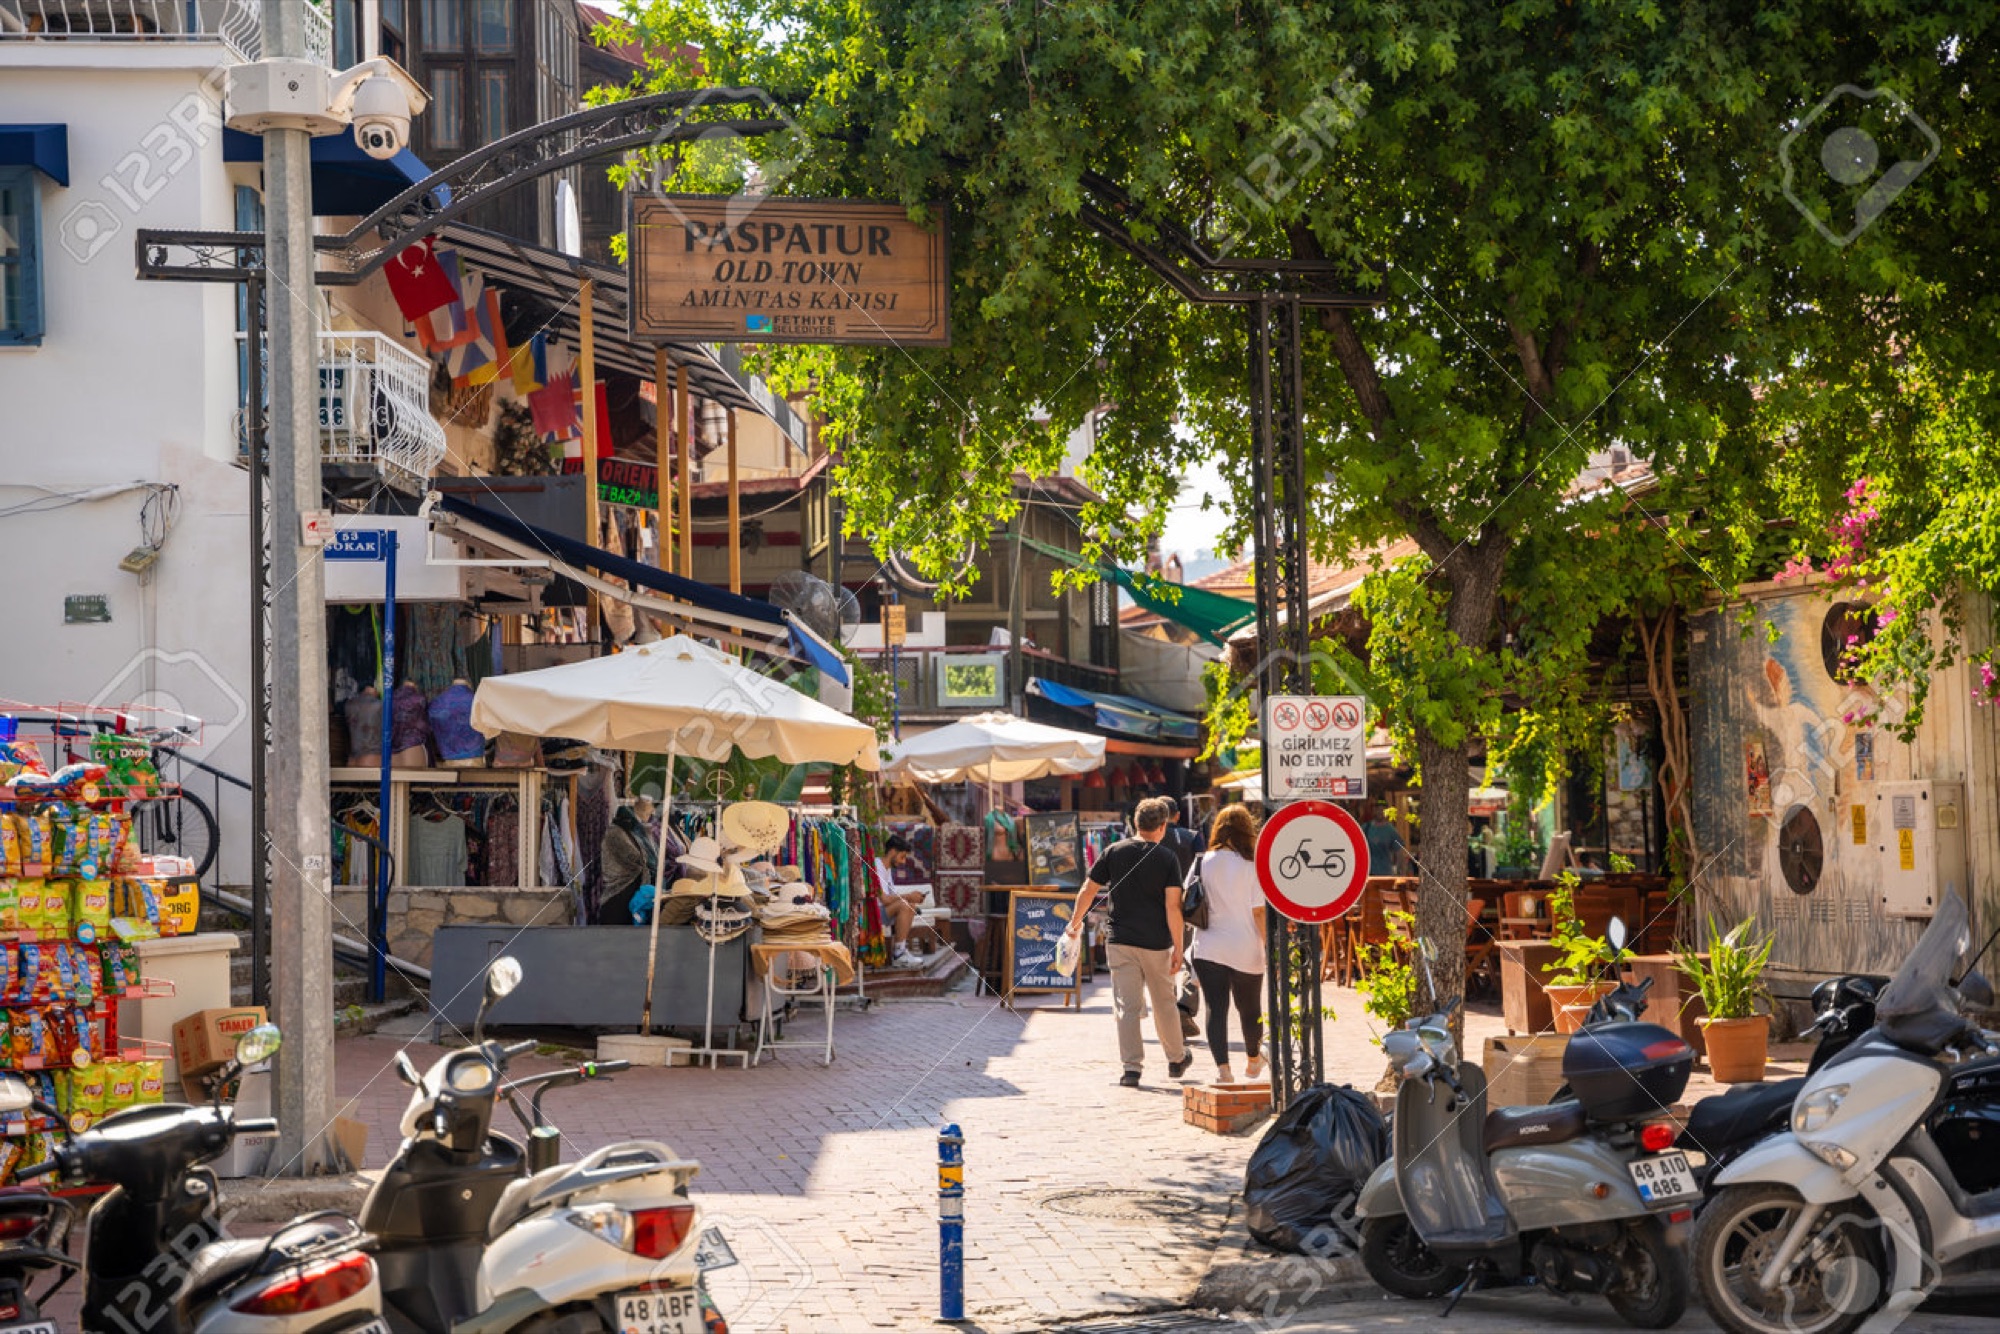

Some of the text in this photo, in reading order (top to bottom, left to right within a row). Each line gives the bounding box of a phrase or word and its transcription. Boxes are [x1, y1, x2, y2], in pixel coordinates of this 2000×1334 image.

[684, 220, 892, 256] PASPATUR
[714, 259, 863, 285] OLD TOWN
[680, 285, 899, 311] AMİNTAS KAPISI
[342, 531, 359, 541] 53
[1282, 734, 1351, 750] GİRİLMEZ
[1279, 753, 1354, 767] NO ENTRY
[1050, 975, 1073, 986] HOUR
[1634, 1156, 1687, 1180] 48 AID
[1651, 1177, 1682, 1197] 486
[624, 1294, 695, 1321] 48 ABF
